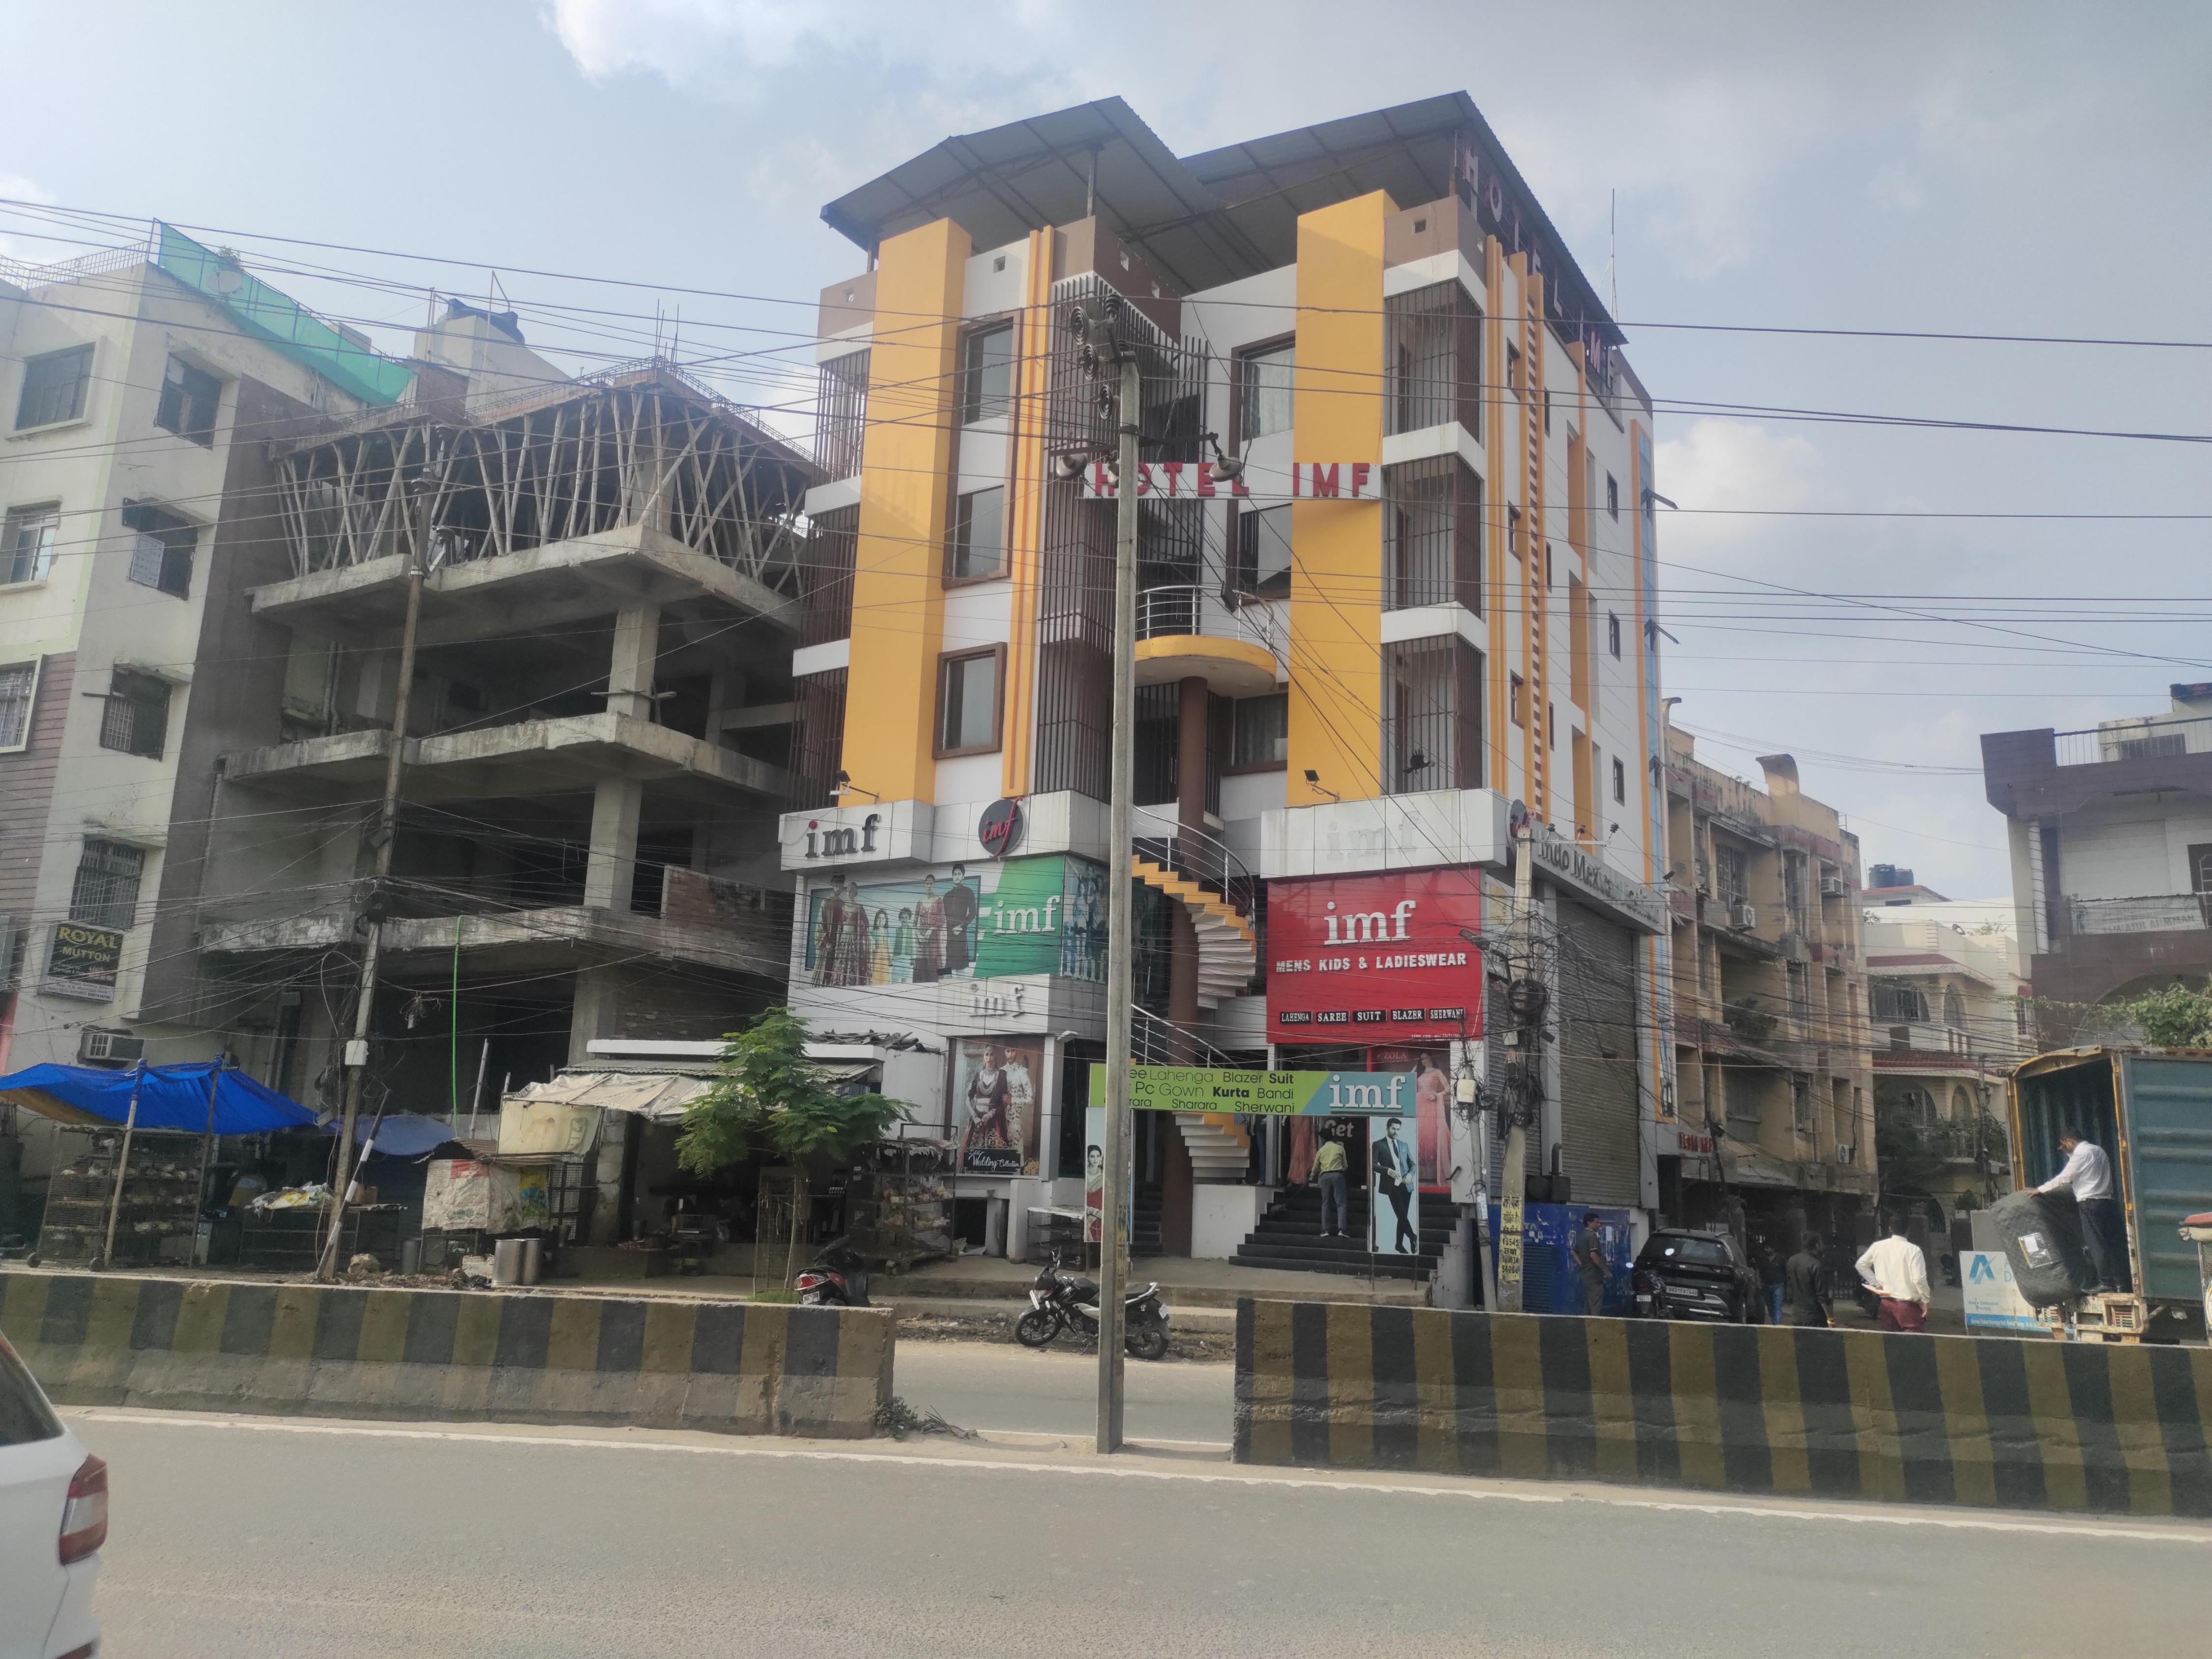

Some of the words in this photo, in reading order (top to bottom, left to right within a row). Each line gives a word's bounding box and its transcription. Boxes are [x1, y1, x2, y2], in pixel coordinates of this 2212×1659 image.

[1292, 462, 1370, 497] IMF
[805, 814, 881, 858] imf
[982, 795, 1024, 858] imf
[993, 895, 1061, 934] imf
[1324, 900, 1417, 945] imf
[58, 927, 117, 949] ROYAL
[62, 946, 111, 962] MUTTON
[1276, 960, 1311, 973] MENS
[1319, 958, 1351, 971] KIDS
[1359, 957, 1368, 969] &
[1376, 953, 1467, 969] LADIESWEAR
[1281, 1013, 1310, 1022] LAHENGA
[1318, 1012, 1347, 1022] SAREE
[1357, 1011, 1381, 1021] SUIT
[1393, 1010, 1423, 1020] BLAZER
[1384, 1051, 1407, 1059] ZOLA
[1150, 1071, 1213, 1084] Lahenga
[1223, 1072, 1262, 1083] Blazer
[1269, 1073, 1294, 1084] Suit
[1135, 1081, 1155, 1094] Pc
[1159, 1083, 1204, 1097] Gown
[1213, 1086, 1250, 1098] Kurta
[1257, 1088, 1293, 1099] Bandi
[1329, 1075, 1406, 1109] imf
[1172, 1099, 1217, 1110] Sharara
[1235, 1101, 1294, 1113] Sherwani
[968, 1151, 997, 1172] Wedding
[997, 1159, 1019, 1167] Collection
